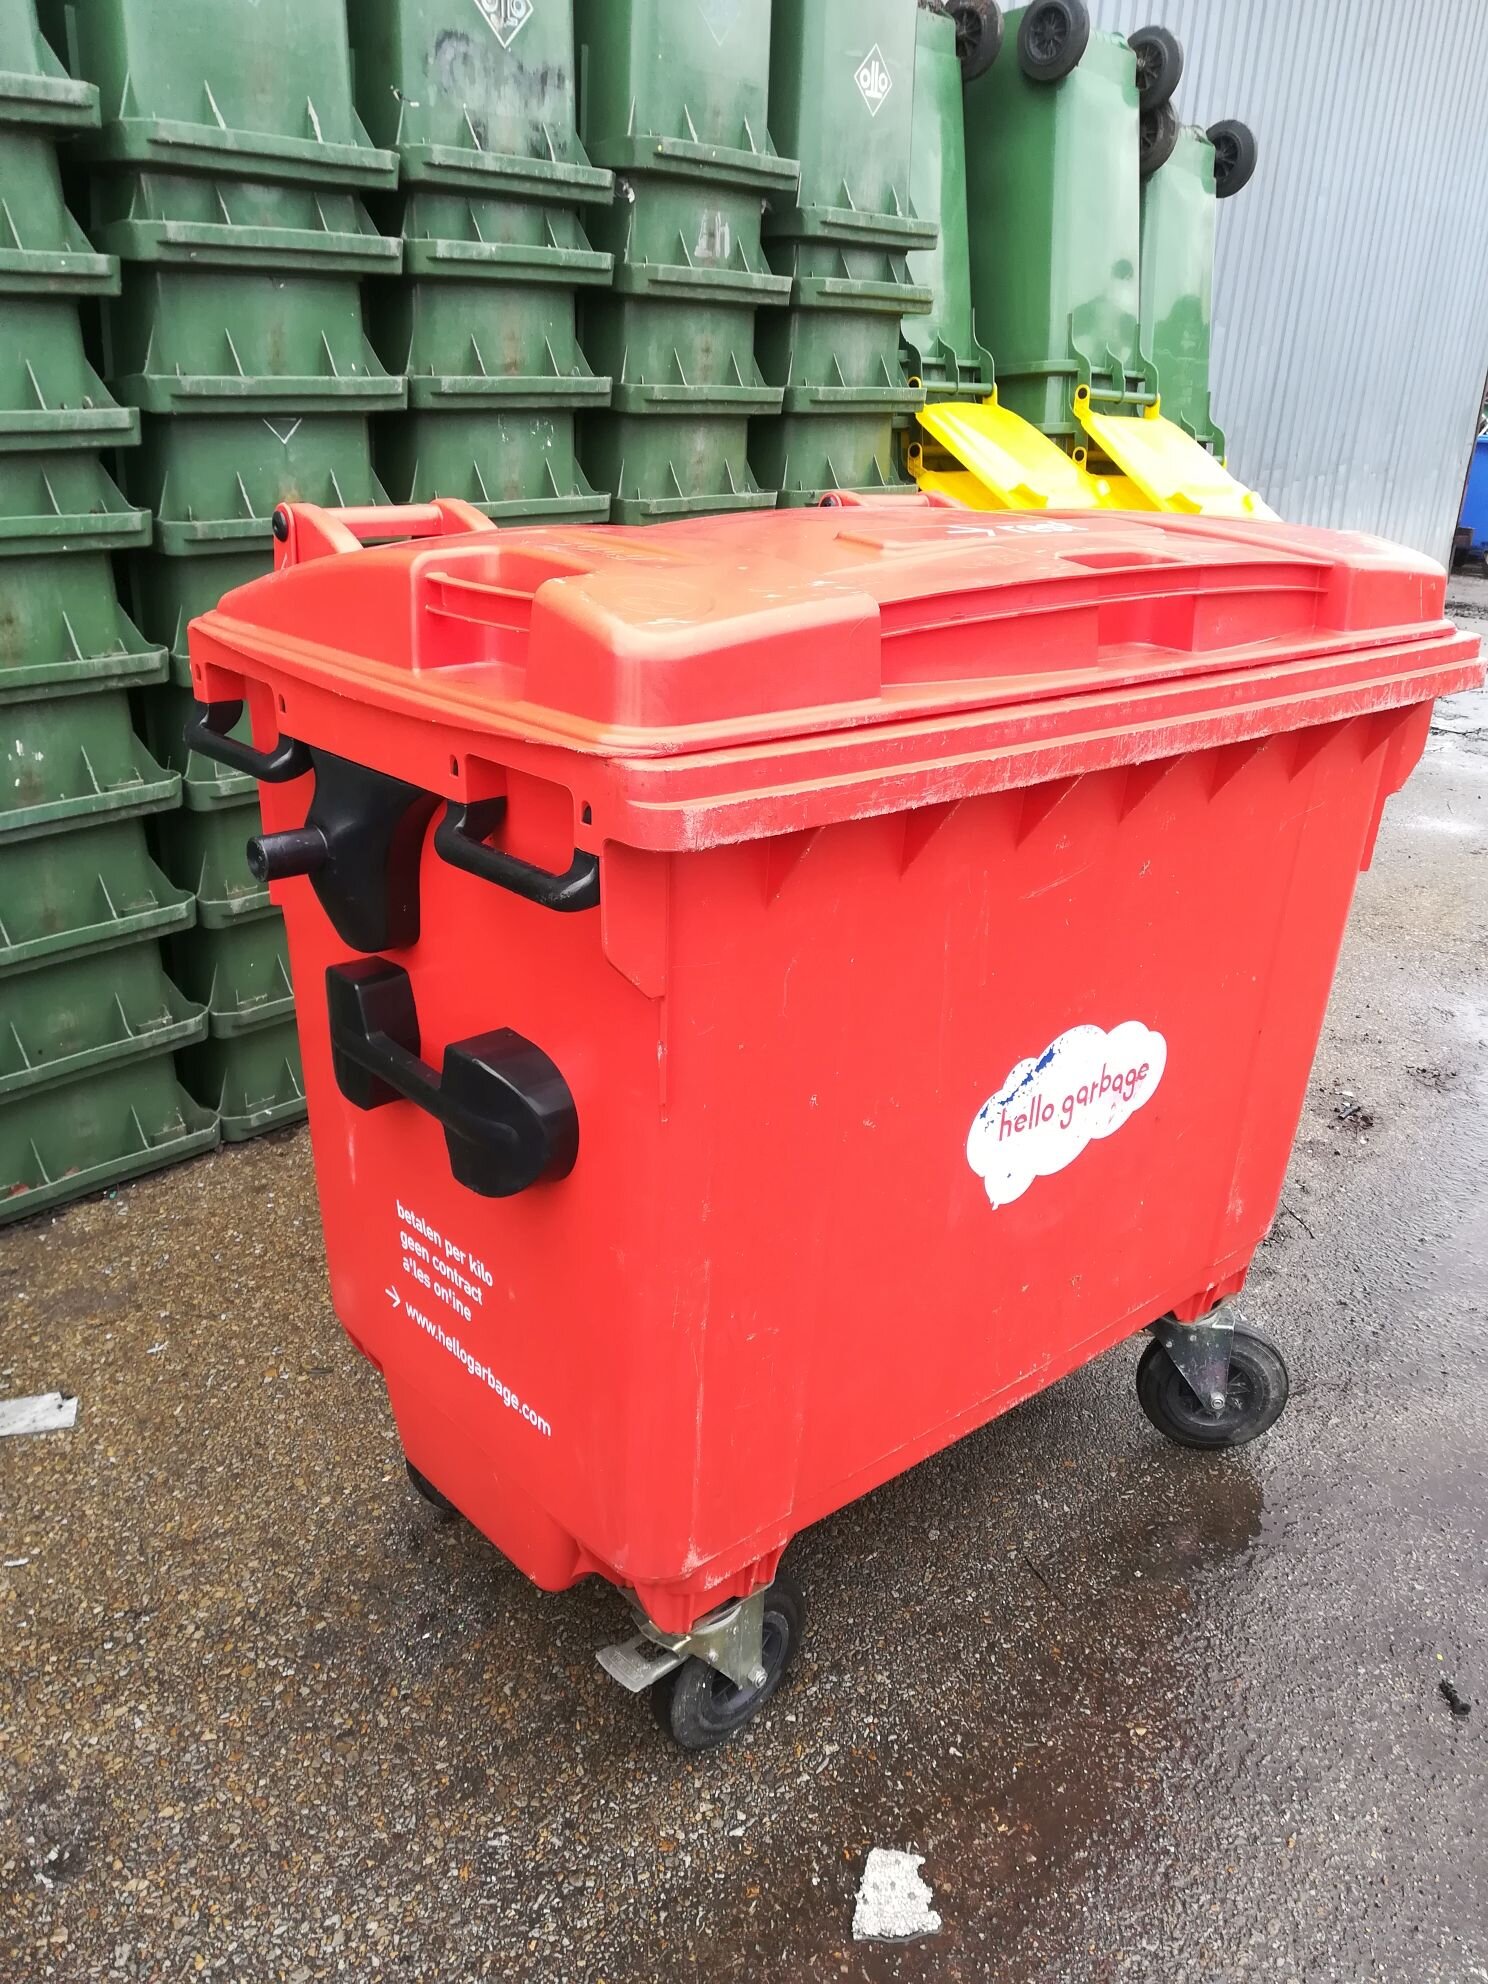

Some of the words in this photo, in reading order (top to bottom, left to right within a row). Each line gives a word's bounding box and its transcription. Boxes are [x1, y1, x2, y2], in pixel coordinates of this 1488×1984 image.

[999, 1094, 1054, 1141] hello
[1060, 1063, 1149, 1129] garbage
[396, 1200, 441, 1247] betalen
[445, 1239, 466, 1264] per
[469, 1254, 493, 1286] kilo
[400, 1231, 429, 1263] geen
[432, 1256, 482, 1305] contract
[405, 1302, 551, 1436] www.hellogarbage.com
